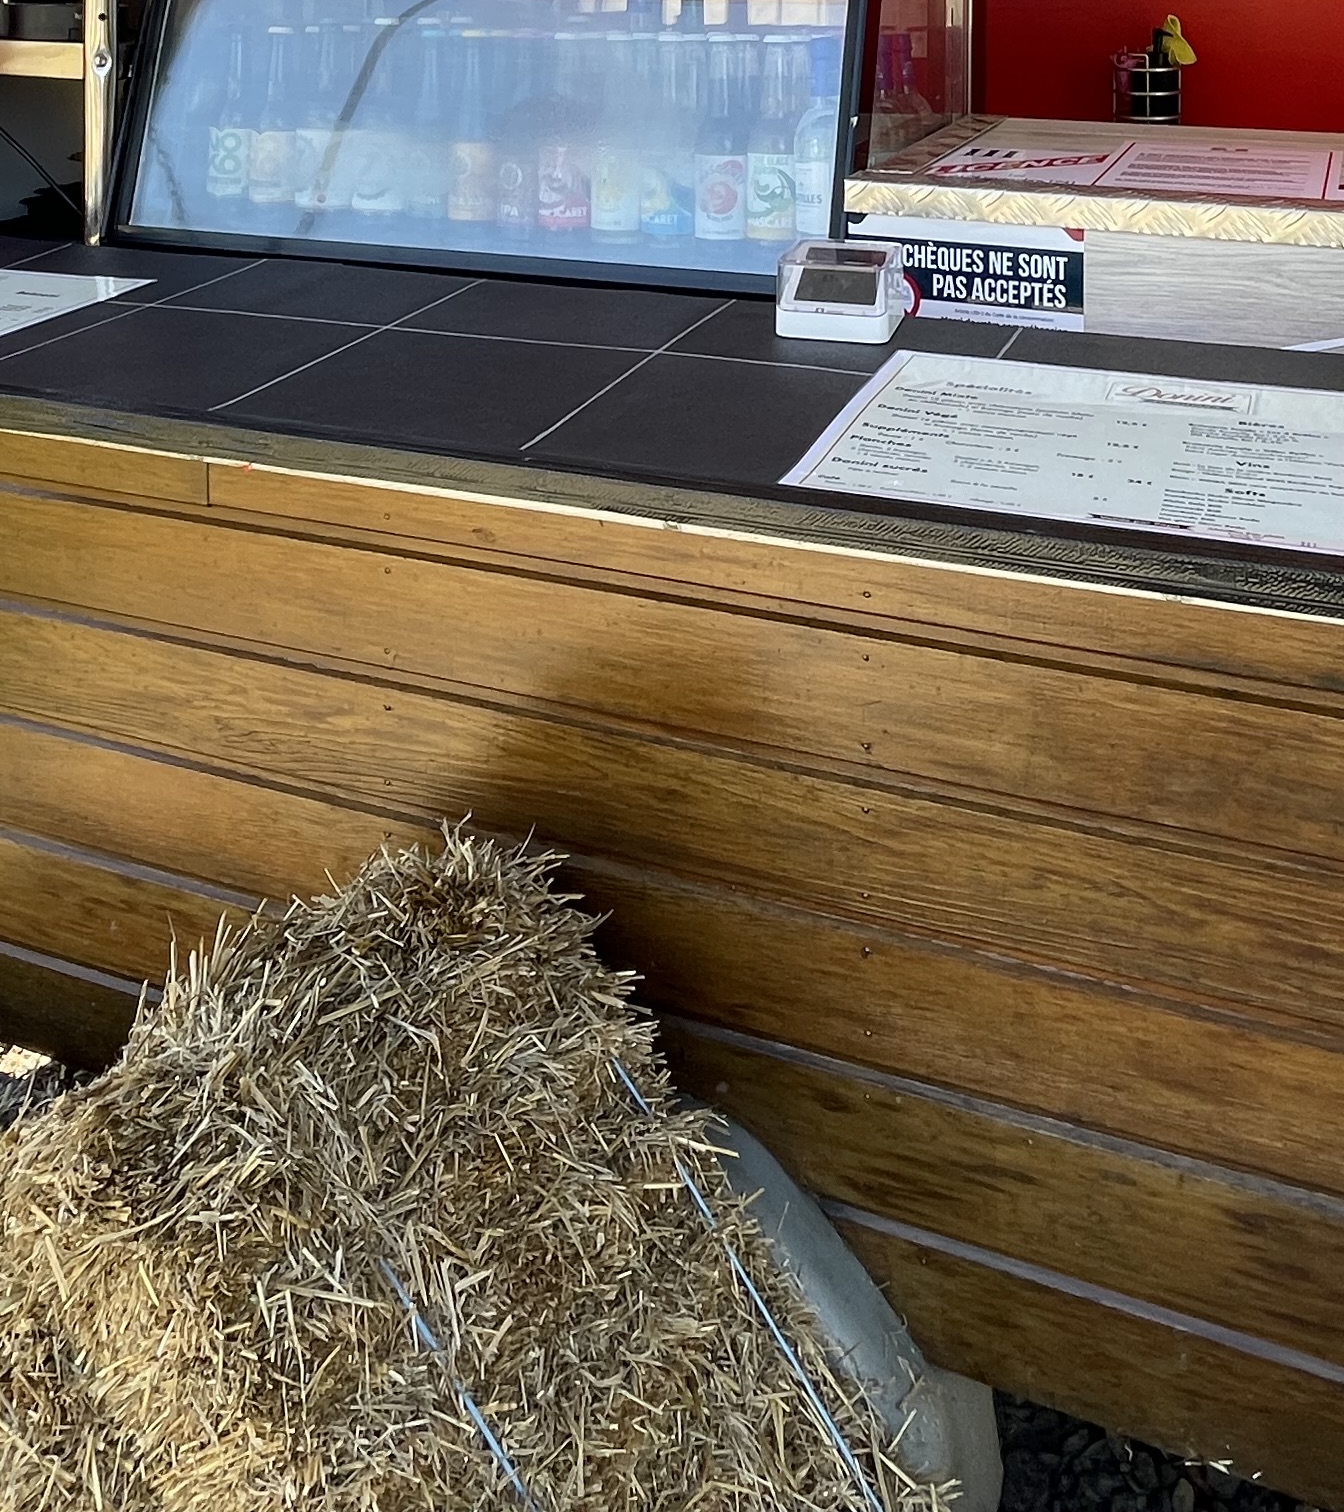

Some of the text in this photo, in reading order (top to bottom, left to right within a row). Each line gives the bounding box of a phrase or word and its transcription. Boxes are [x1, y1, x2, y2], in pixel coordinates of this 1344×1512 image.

[902, 241, 1068, 281] CHÈQUES NE SONT
[933, 273, 1066, 309] PAS ACCEPTÉS
[1115, 386, 1235, 405] Donini
[1236, 460, 1270, 469] Vins
[1225, 488, 1266, 497] Softs
